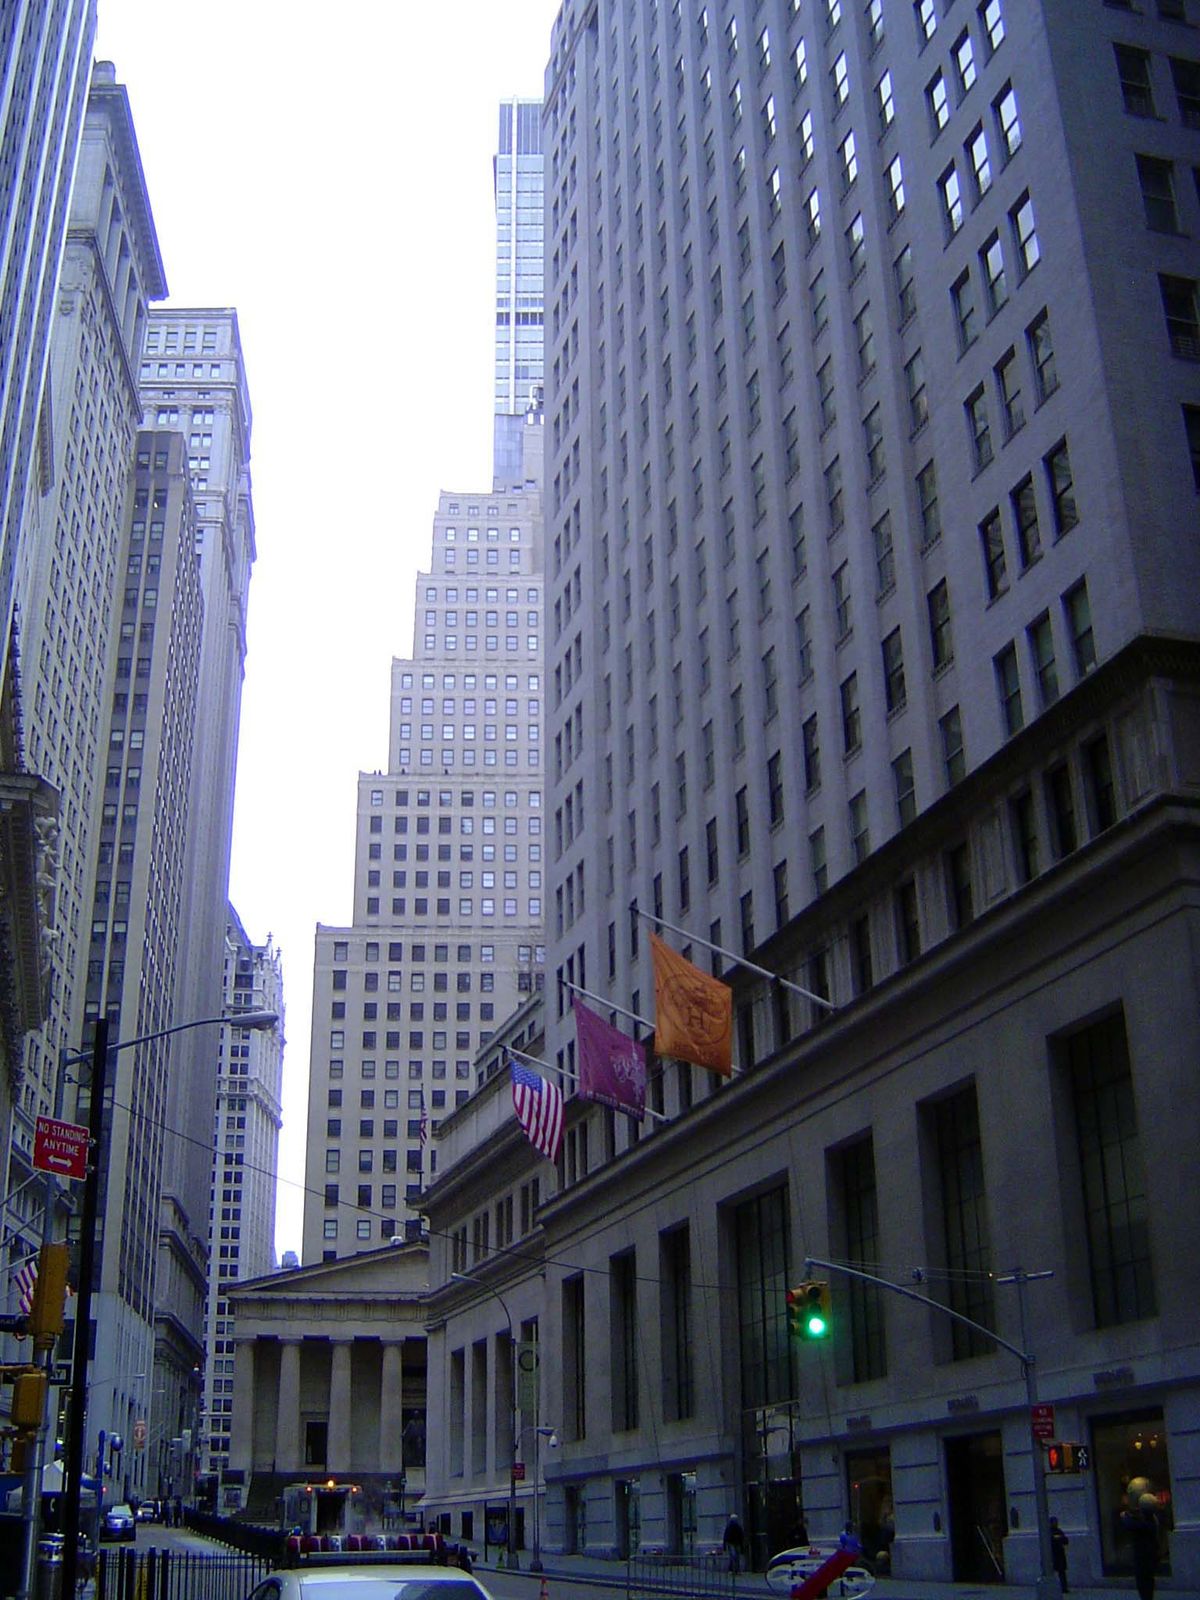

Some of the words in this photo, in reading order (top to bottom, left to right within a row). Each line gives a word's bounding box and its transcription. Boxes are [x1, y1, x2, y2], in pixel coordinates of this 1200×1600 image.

[38, 1121, 50, 1134] NO
[51, 1125, 86, 1144] STANDING
[43, 1138, 80, 1157] ANYTIME
